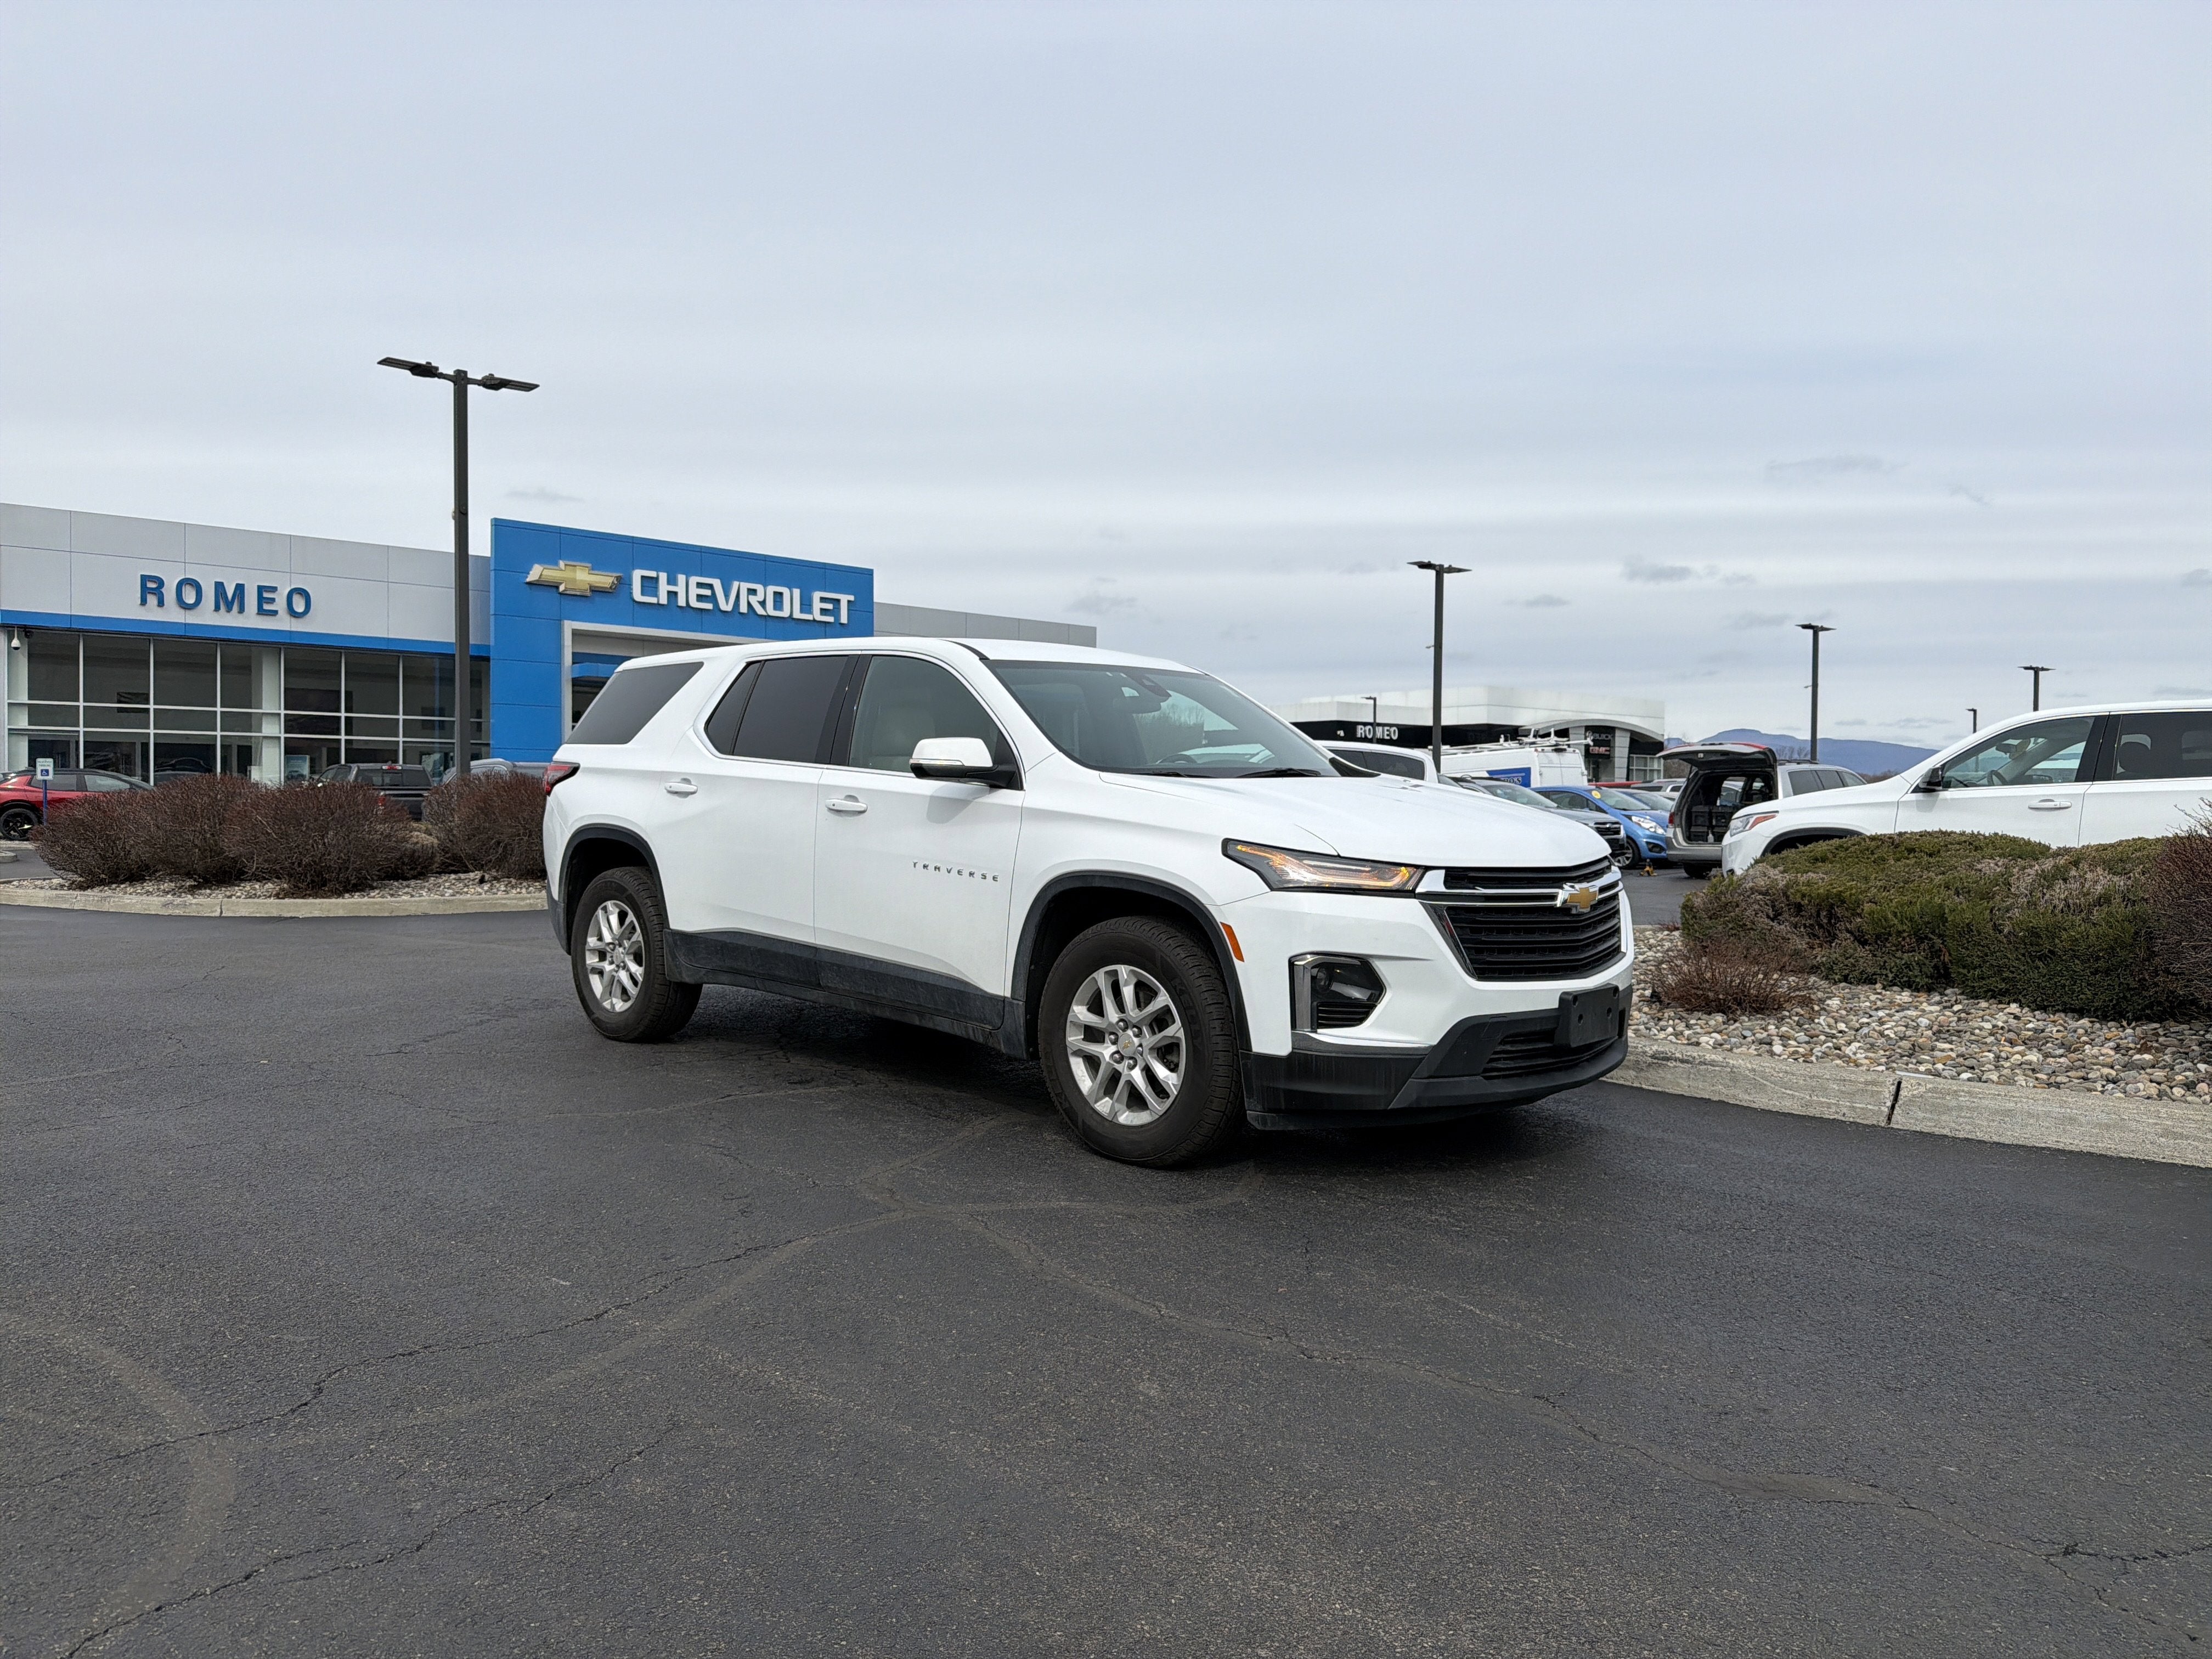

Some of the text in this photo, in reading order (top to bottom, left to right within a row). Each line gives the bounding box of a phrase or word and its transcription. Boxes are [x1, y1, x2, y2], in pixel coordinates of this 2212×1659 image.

[139, 574, 312, 618] ROMEO
[632, 569, 855, 624] CHEVROLET
[1356, 725, 1398, 740] ROMEO
[912, 861, 999, 882] TRAVERSE
